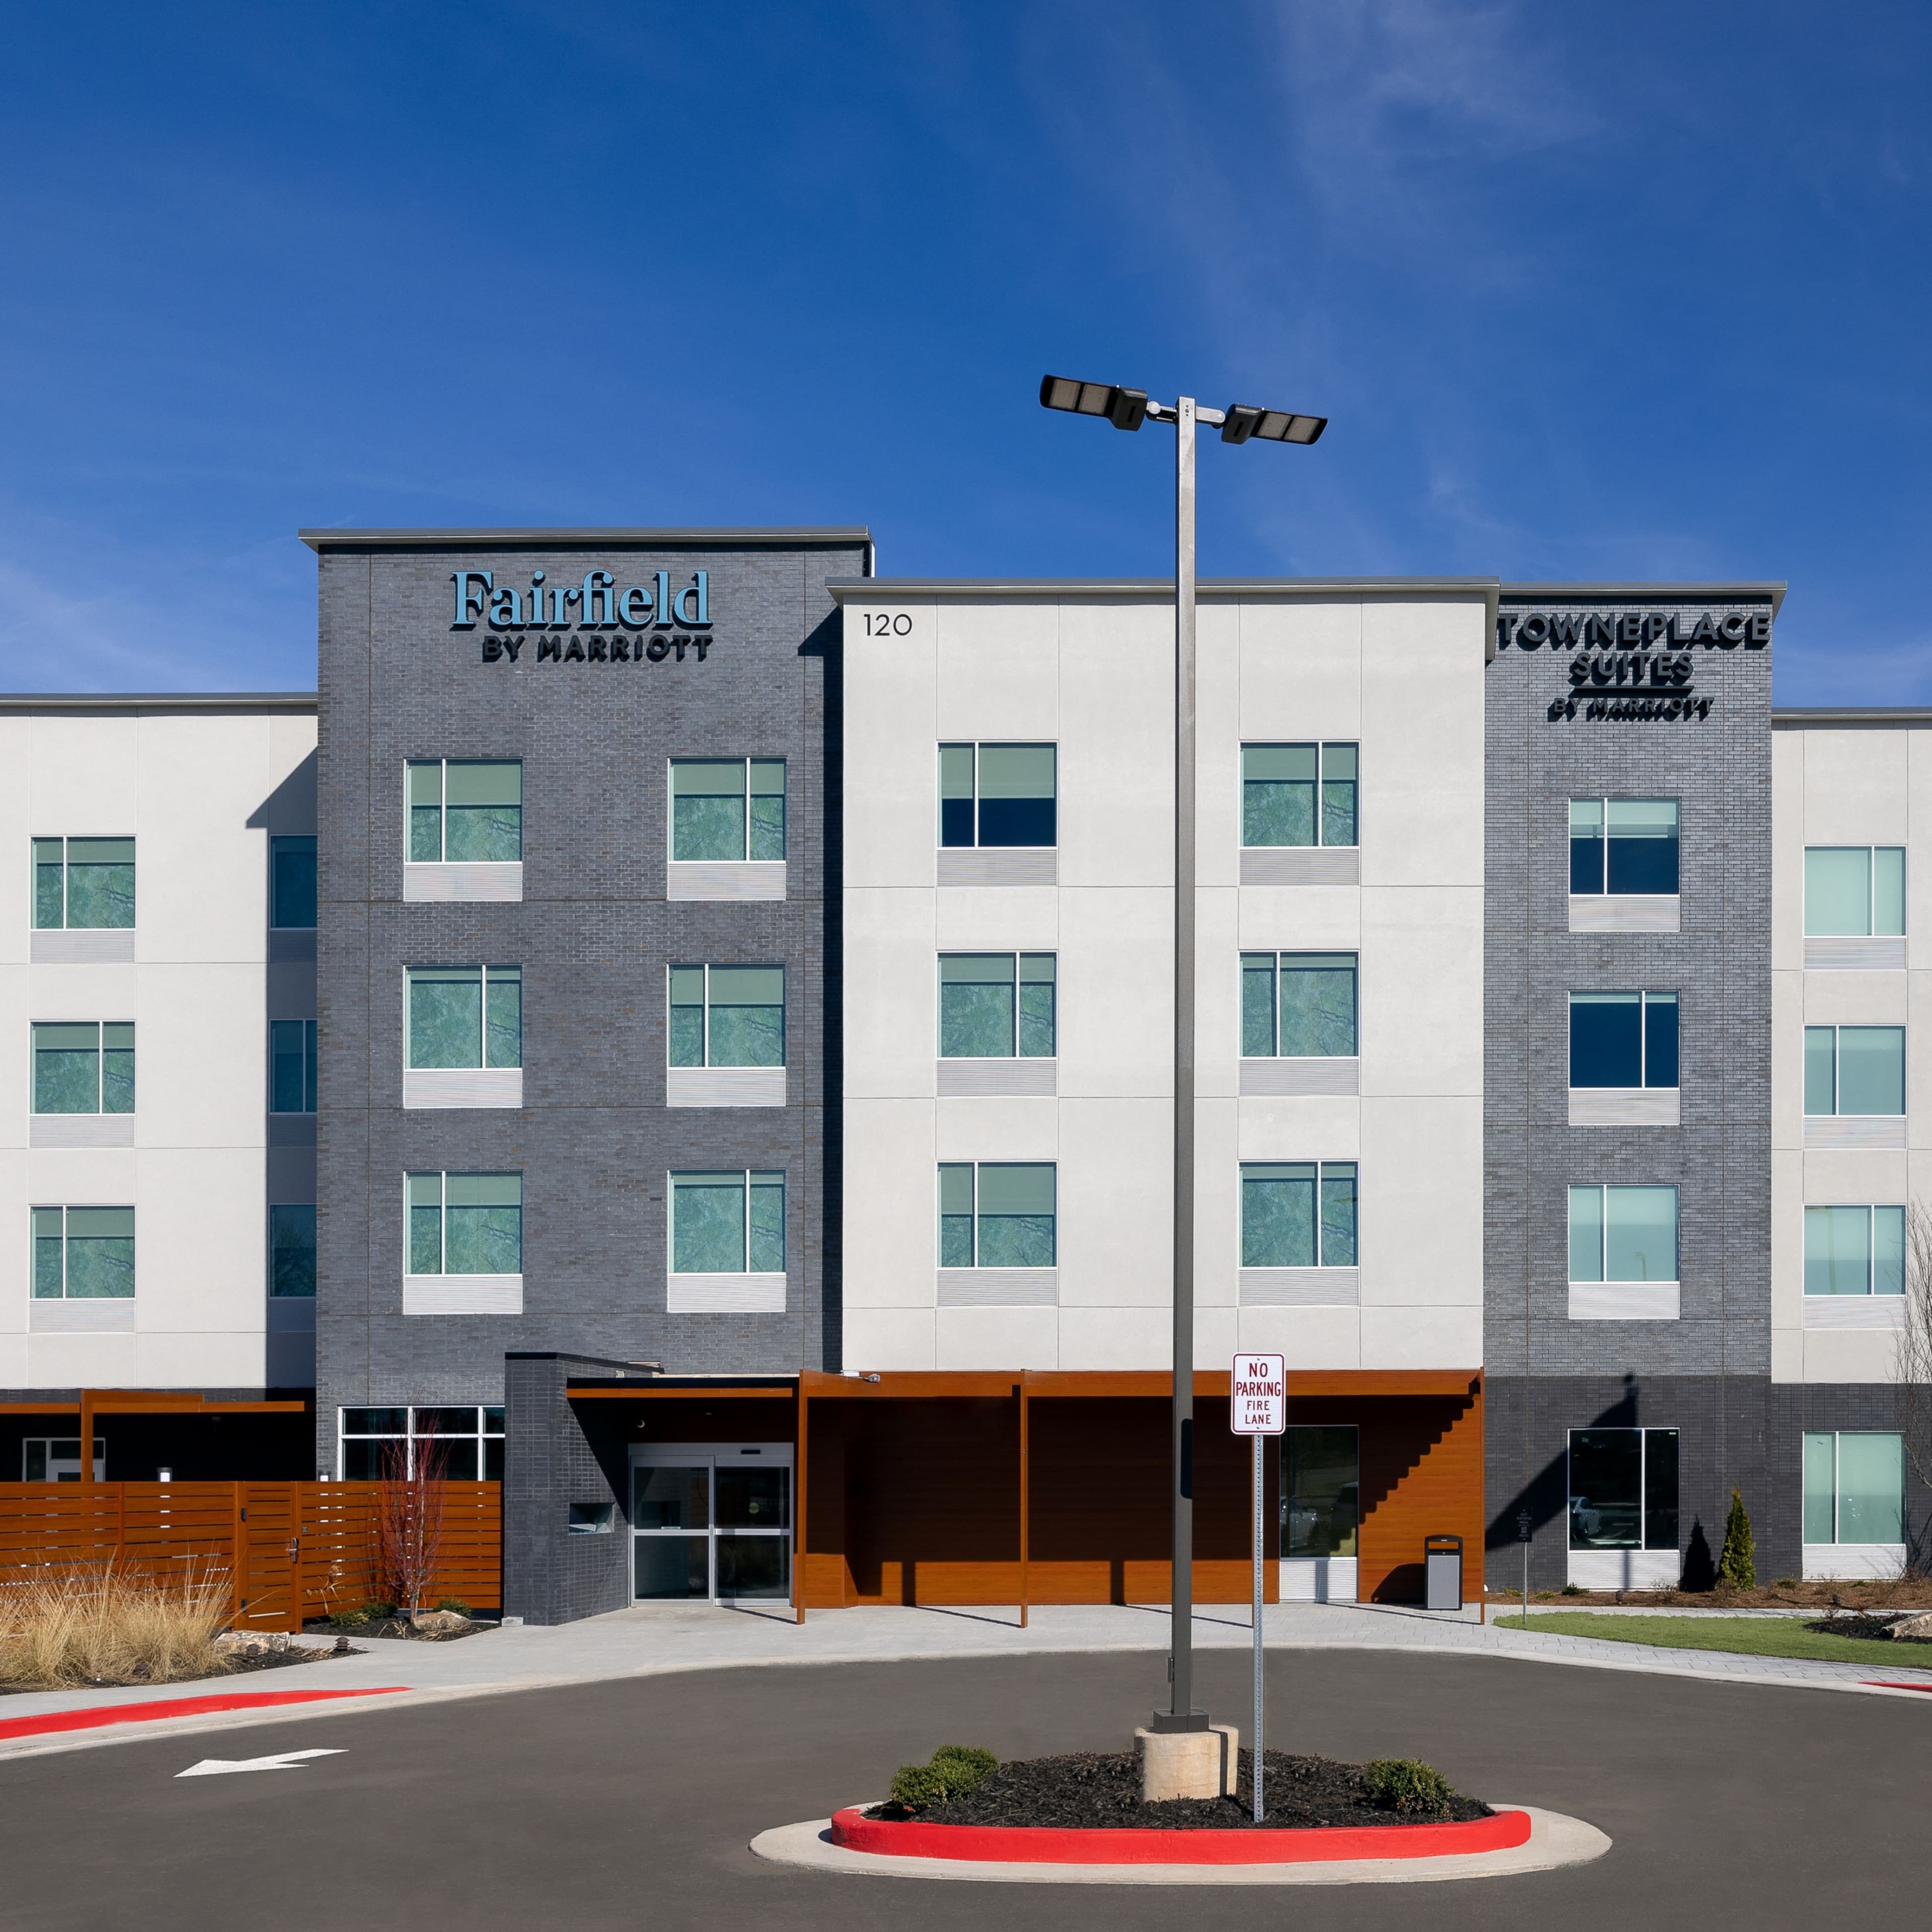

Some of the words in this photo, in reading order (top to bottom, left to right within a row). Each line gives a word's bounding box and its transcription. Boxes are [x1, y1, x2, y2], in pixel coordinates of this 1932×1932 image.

[451, 569, 712, 625] Fairfield
[863, 613, 912, 636] 120
[1499, 612, 1770, 641] TOWNEPLACE
[484, 635, 525, 656] BY
[539, 634, 713, 656] MARRIOTT
[1574, 652, 1694, 676] SUITES
[1554, 697, 1581, 712] BY
[1593, 697, 1714, 712] MARRIOTT
[1249, 1363, 1268, 1377] NO
[1236, 1382, 1281, 1396] PARKING
[1247, 1401, 1269, 1410] FIRE
[1245, 1414, 1271, 1424] LANE
